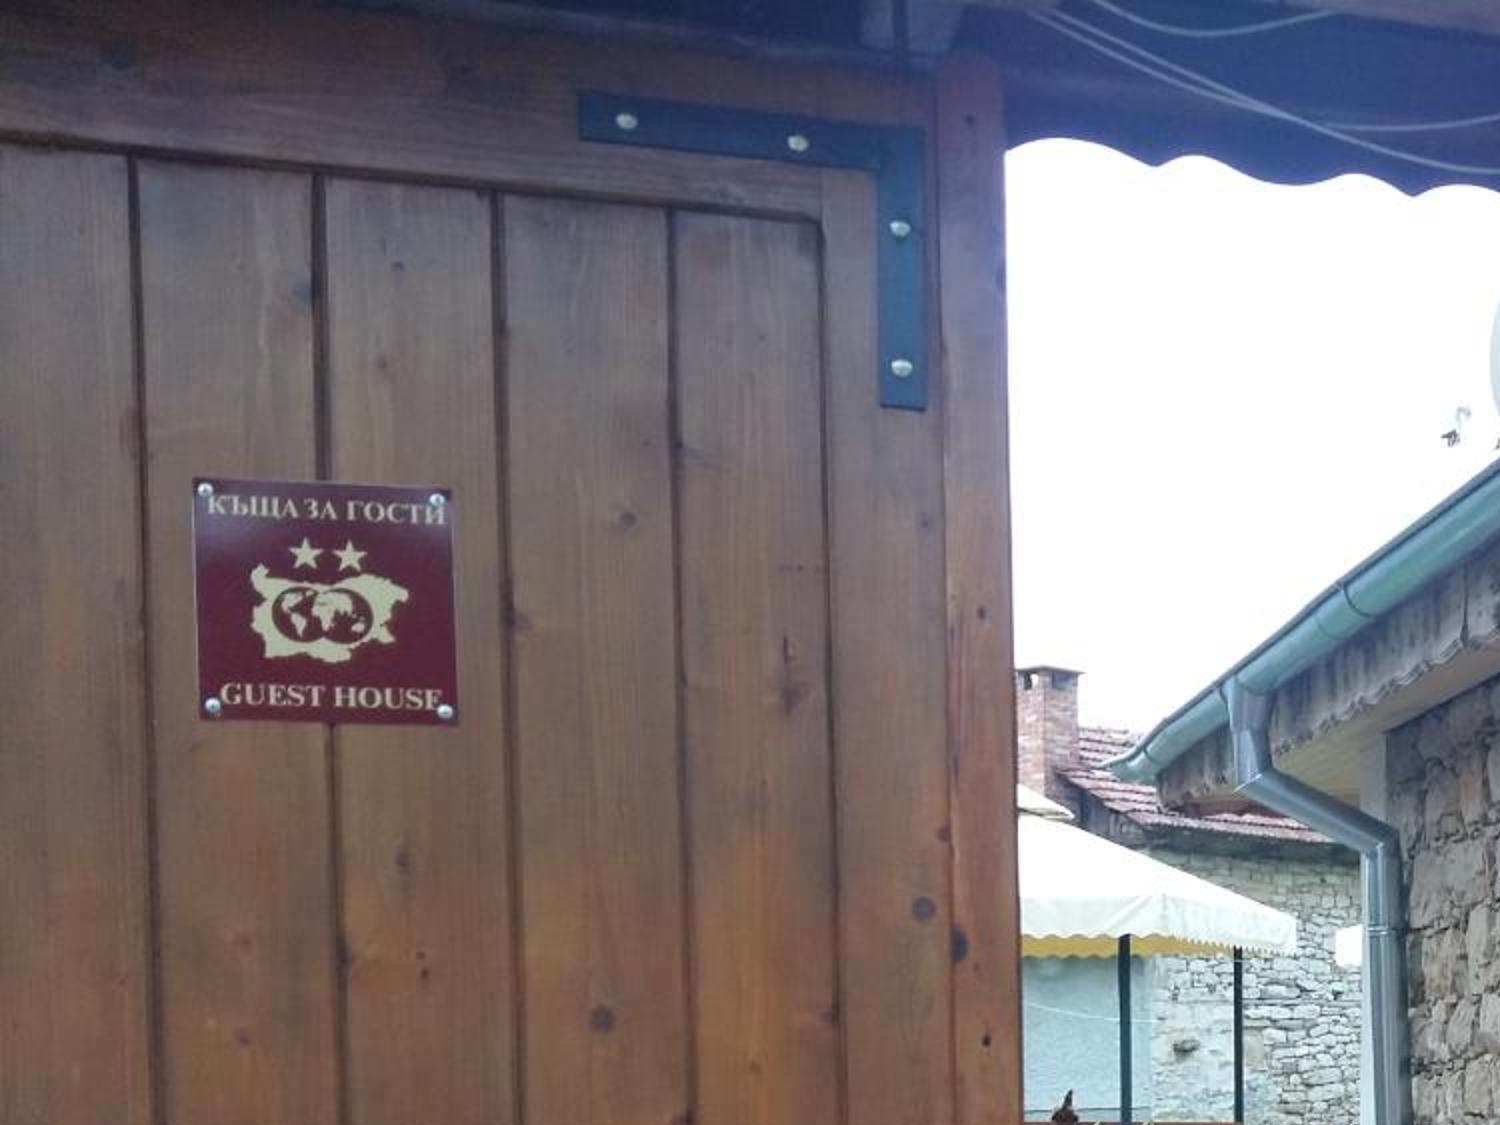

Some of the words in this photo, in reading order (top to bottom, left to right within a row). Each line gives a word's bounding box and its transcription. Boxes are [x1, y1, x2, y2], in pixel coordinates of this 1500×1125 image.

[207, 494, 298, 521] КЪЩА
[303, 499, 337, 520] ЗА
[346, 500, 447, 526] ГОСТИ
[220, 682, 326, 707] GUEST
[334, 685, 442, 711] HOUSE
